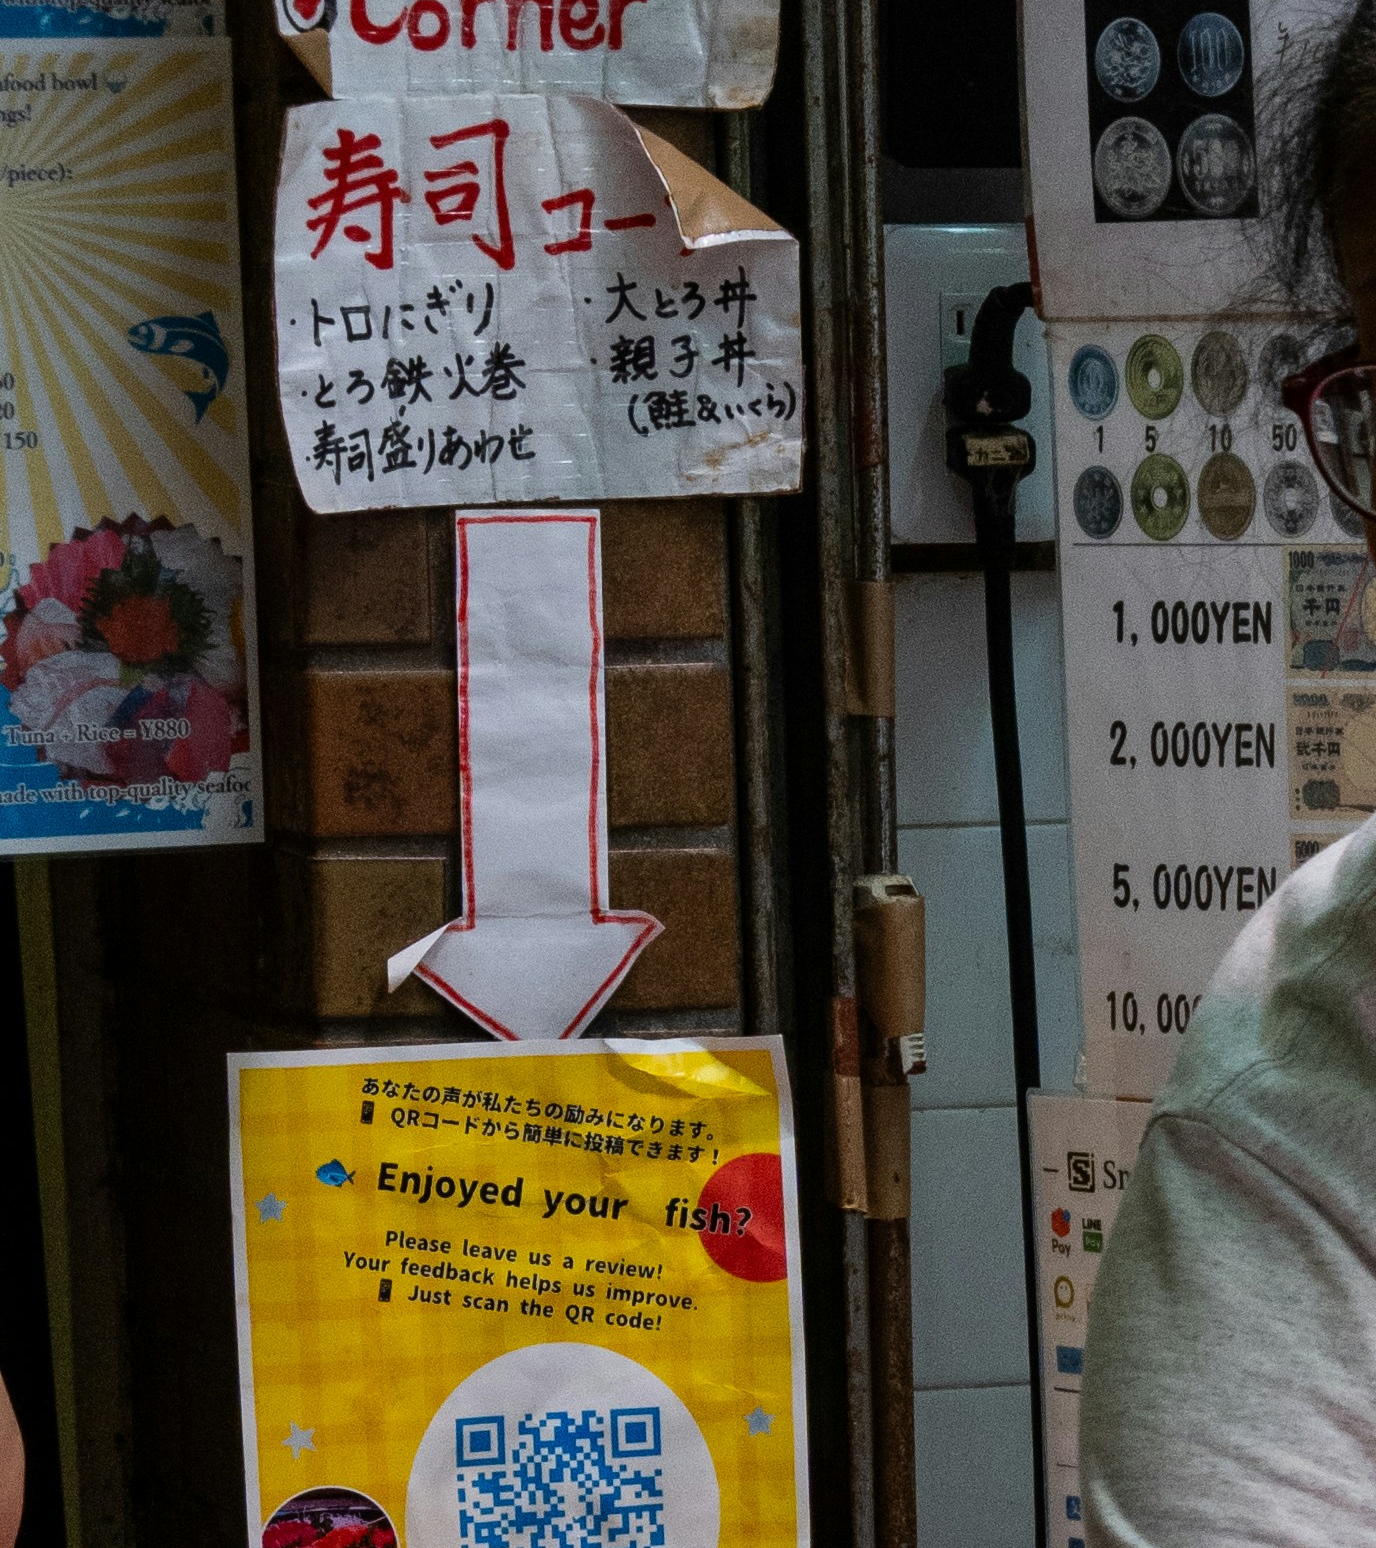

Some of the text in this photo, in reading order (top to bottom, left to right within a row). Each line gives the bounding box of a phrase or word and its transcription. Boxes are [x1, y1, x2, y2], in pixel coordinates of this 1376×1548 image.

[52, 72, 98, 92] bowl
[606, 335, 758, 388] 親子丼
[4, 431, 39, 450] 150
[1095, 424, 1298, 453] 1 5 10 50
[1302, 597, 1341, 616] 千円
[7, 727, 55, 746] Tuna
[76, 722, 121, 742] Rice
[41, 781, 87, 803] with
[377, 1161, 754, 1238] Enjoyed your fish?
[384, 1229, 665, 1281] Please leave us a review!
[342, 1249, 699, 1313] Your feedback helps us improve.
[408, 1283, 664, 1333] Just scan the QR code!
